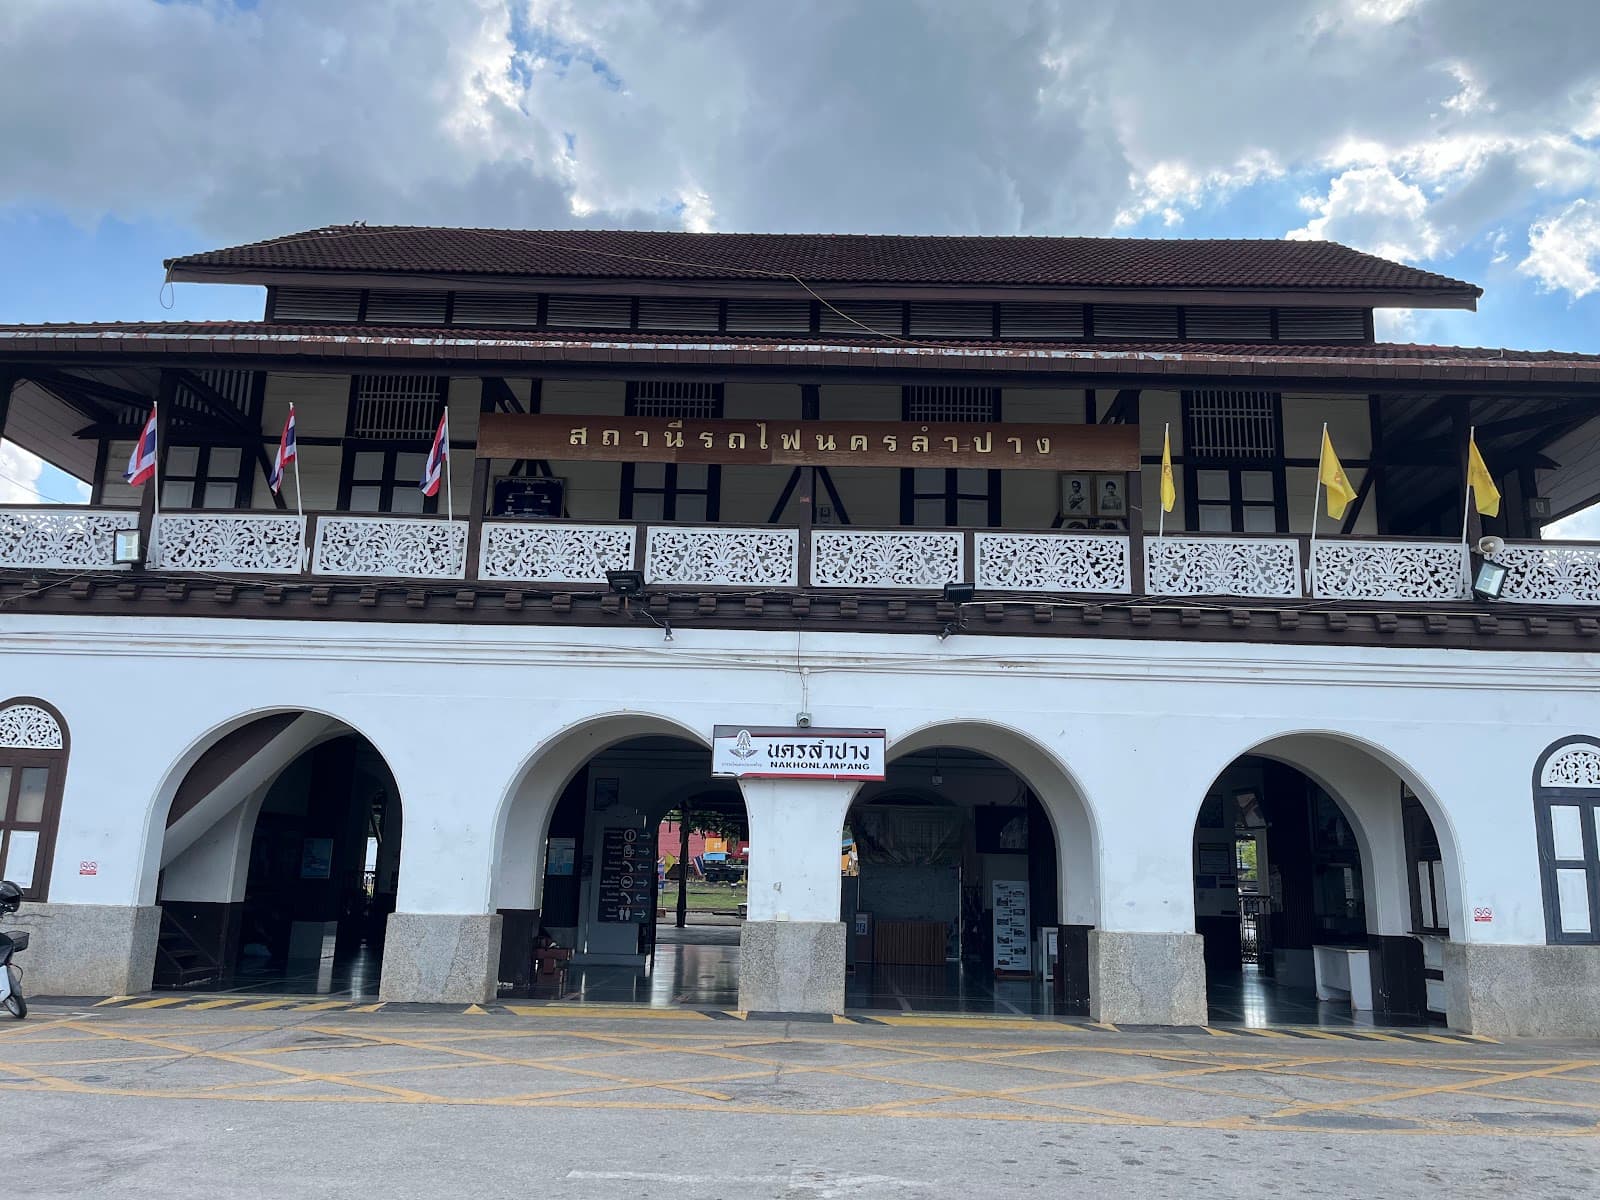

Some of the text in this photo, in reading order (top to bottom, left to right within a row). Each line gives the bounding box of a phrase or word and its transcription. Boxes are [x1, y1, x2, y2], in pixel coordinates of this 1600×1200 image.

[569, 419, 1050, 454] สถานีรถไฟนครลำปาง
[767, 740, 870, 761] นครลำปาง
[770, 761, 870, 770] NAKHONLAMPANG
